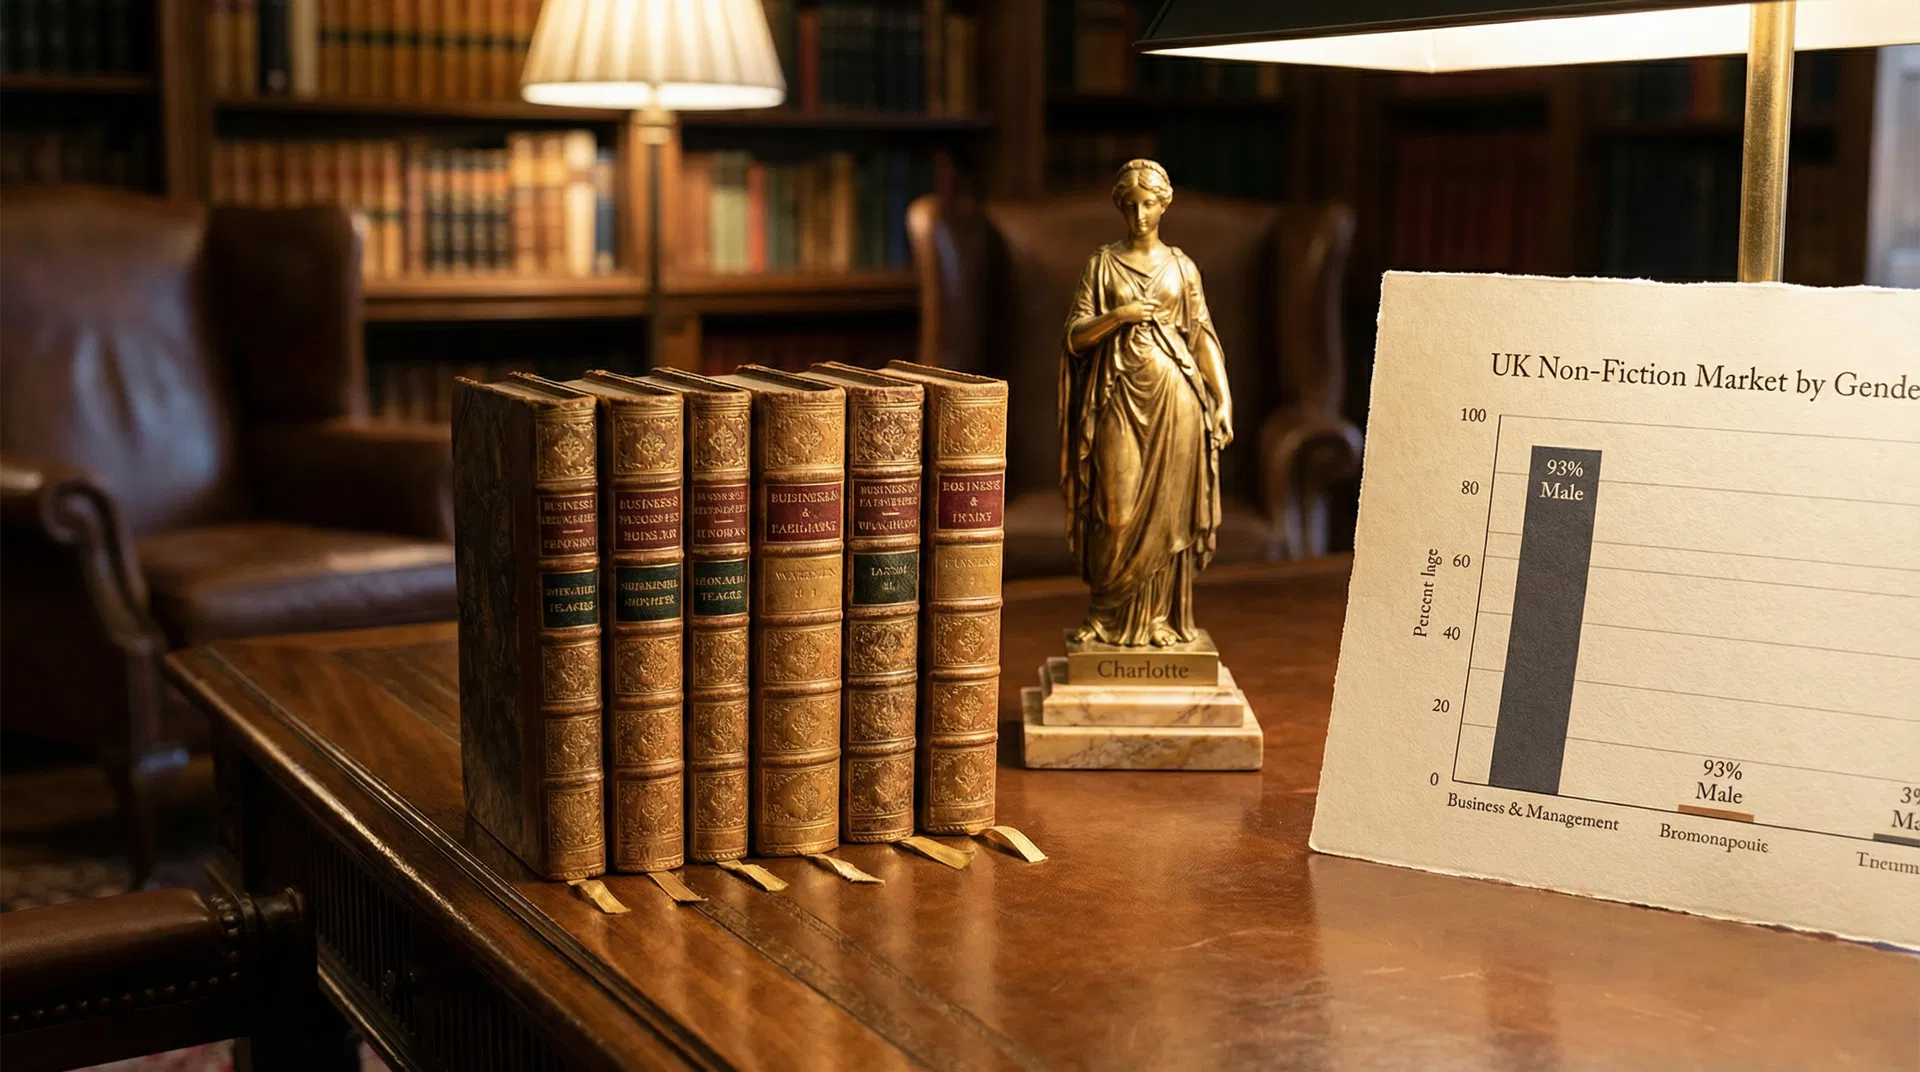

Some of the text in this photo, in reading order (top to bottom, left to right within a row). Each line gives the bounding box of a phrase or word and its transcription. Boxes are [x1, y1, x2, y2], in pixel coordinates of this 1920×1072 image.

[1491, 352, 1531, 377] UK
[1537, 355, 1687, 387] Non-Fiction
[1694, 363, 1788, 393] Market
[1796, 369, 1826, 402] by
[1461, 408, 1487, 422] 100
[1547, 459, 1584, 478] 93%
[1461, 480, 1479, 495] 80
[1539, 481, 1584, 501] Male
[1453, 554, 1471, 568] 60
[1443, 626, 1461, 641] 40
[1097, 660, 1189, 679] Charlotte
[1432, 698, 1450, 713] 20
[1430, 772, 1439, 786] 0
[1703, 759, 1743, 781] 93%
[1695, 781, 1743, 804] Male
[1447, 792, 1620, 831] Business & Management
